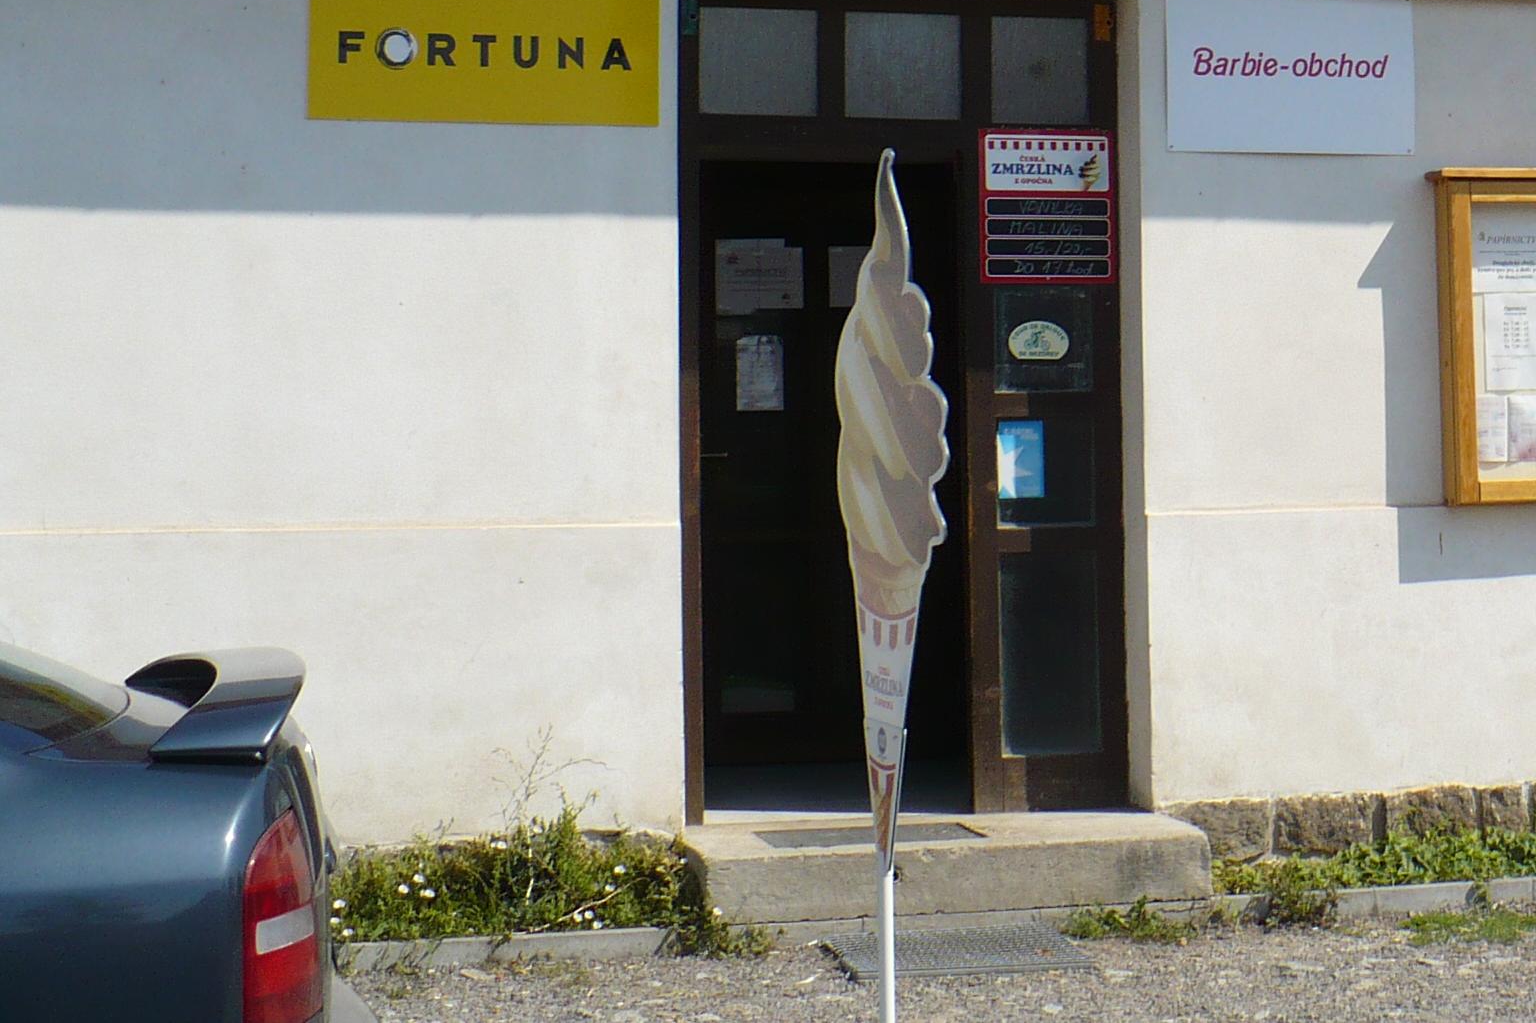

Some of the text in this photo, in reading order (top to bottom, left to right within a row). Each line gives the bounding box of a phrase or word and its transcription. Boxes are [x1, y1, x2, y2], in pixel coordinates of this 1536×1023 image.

[338, 27, 632, 72] FORTUNA
[1193, 47, 1389, 81] Barbie-obchod
[992, 163, 1074, 176] ZMRZLINA
[1009, 221, 1083, 236] MALINA
